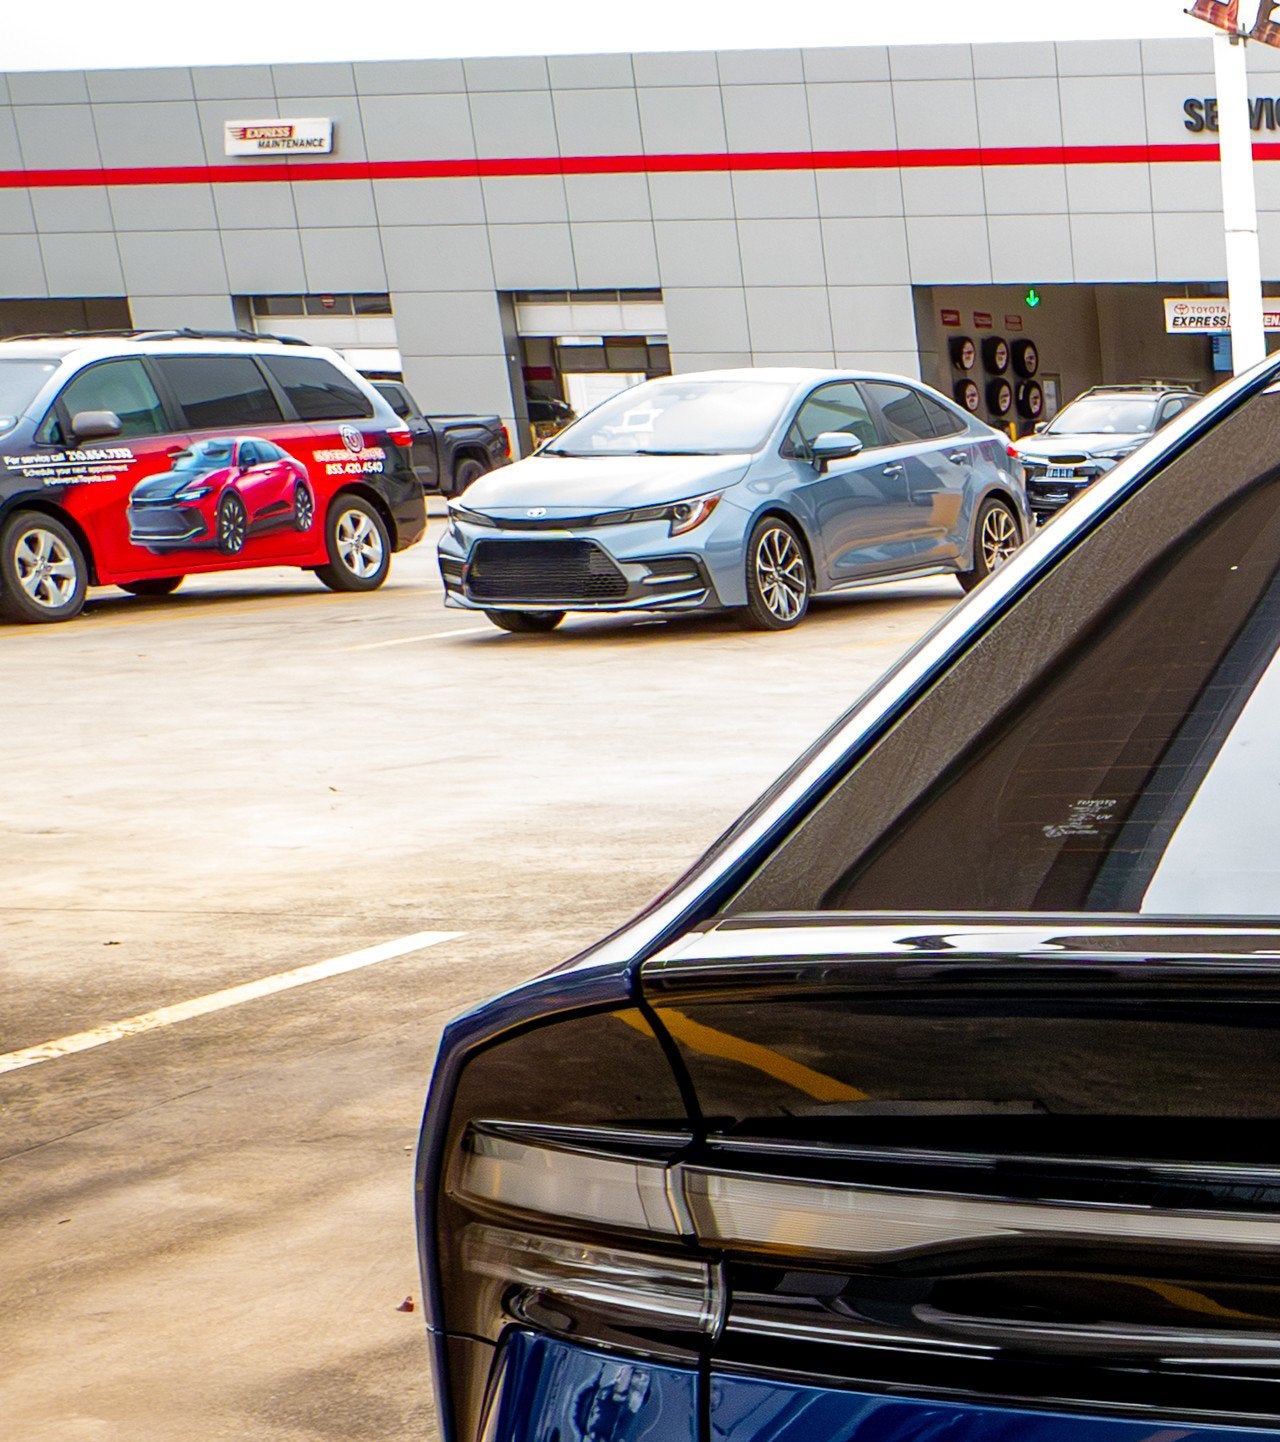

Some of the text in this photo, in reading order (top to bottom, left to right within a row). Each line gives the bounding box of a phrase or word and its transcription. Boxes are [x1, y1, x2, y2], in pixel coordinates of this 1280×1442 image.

[246, 128, 290, 139] EXPRESS
[258, 139, 324, 149] MAINTENANCE
[1191, 306, 1227, 314] TOYOTA
[1172, 316, 1227, 326] EXPRESS
